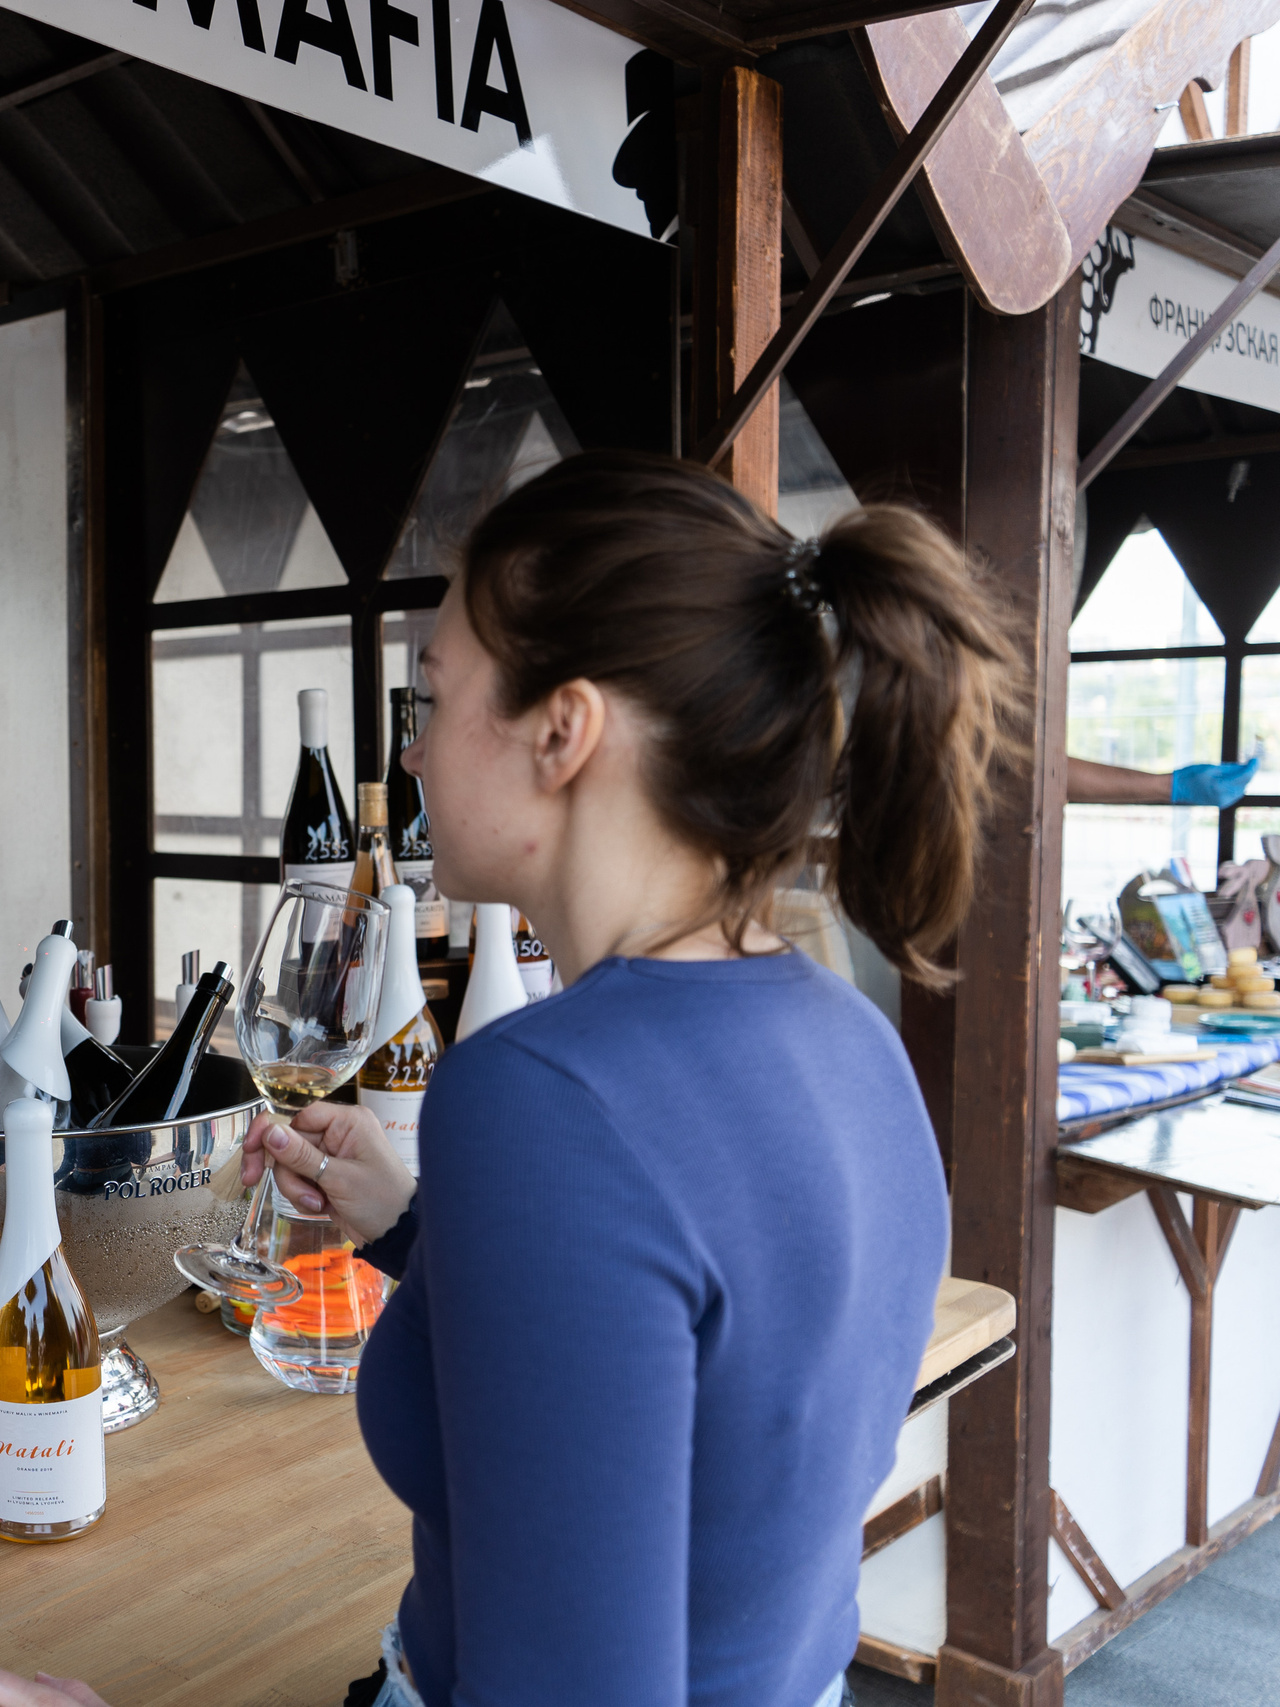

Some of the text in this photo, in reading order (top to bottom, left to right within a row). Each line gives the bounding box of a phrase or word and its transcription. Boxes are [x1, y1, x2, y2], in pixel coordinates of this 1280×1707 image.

[1149, 292, 1278, 366] ФРАНЗСКАЯ
[104, 1168, 212, 1200] POL ROGER
